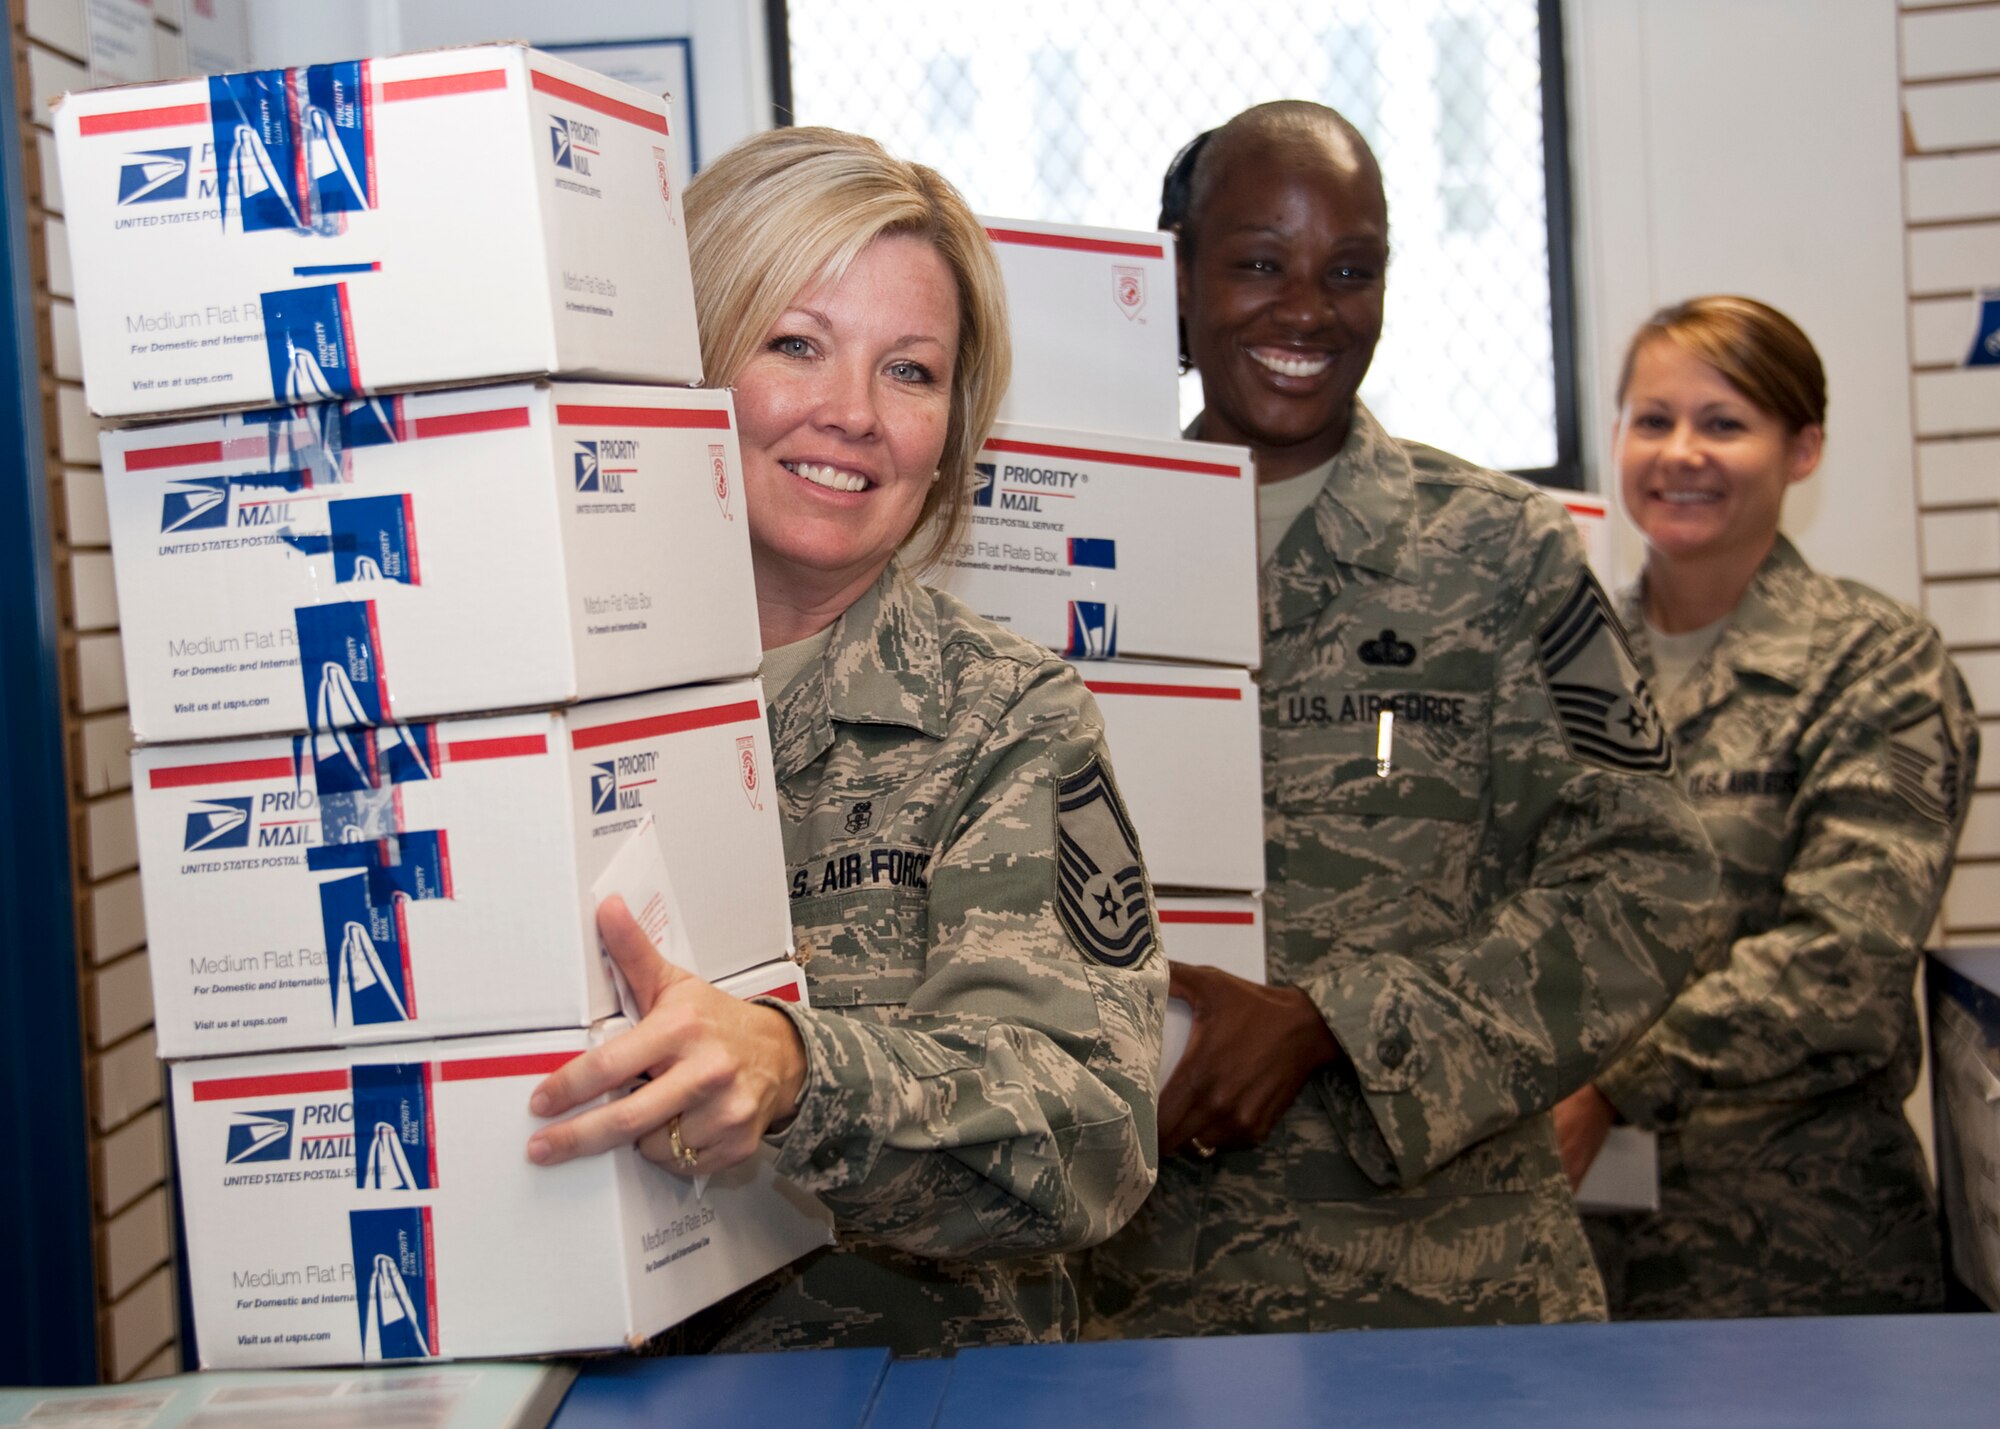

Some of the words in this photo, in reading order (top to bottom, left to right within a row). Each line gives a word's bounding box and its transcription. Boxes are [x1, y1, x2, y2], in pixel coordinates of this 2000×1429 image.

[333, 79, 345, 127] PRIORITY
[260, 98, 271, 145] PRIORITY
[344, 102, 355, 128] MAIL
[570, 119, 600, 147] PRIORITY
[115, 215, 158, 230] UNITED
[160, 211, 200, 225] STATES
[126, 311, 201, 334] Medium
[206, 303, 239, 326] Flat
[131, 344, 148, 354] For
[151, 337, 199, 353] Domestic
[201, 335, 220, 347] and
[314, 321, 331, 368] PRIORITY
[327, 342, 339, 368] MAIL
[132, 380, 155, 391] Visit
[157, 381, 169, 389] us
[172, 379, 182, 388] at
[185, 373, 233, 386] usps.com
[600, 440, 636, 460] PRIORITY
[602, 475, 624, 493] MAIL
[1003, 465, 1078, 489] PRIORITY
[1000, 493, 1043, 513] MAIL
[238, 502, 296, 528] MAIL
[971, 515, 1000, 527] STATES
[1000, 518, 1031, 530] POSTAL
[1032, 520, 1064, 532] SERVICE
[159, 542, 200, 556] UNITED
[201, 539, 239, 552] STATES
[379, 528, 392, 576] PRIORITY
[978, 541, 1001, 558] Flat
[1002, 544, 1032, 560] Rate
[1034, 547, 1058, 563] Box
[955, 560, 991, 570] Domestic
[992, 563, 1008, 572] and
[1009, 565, 1056, 576] International
[169, 636, 240, 658] Medium
[245, 631, 276, 650] Flat
[280, 627, 300, 647] Ra
[173, 668, 190, 678] For
[191, 663, 237, 676] Domestic
[239, 660, 258, 672] and
[174, 703, 195, 714] Visit
[197, 703, 209, 711] us
[212, 701, 221, 710] at
[223, 697, 270, 711] usps.com
[1288, 696, 1333, 723] U.S.
[1339, 694, 1384, 722] AIR
[1392, 692, 1466, 725] FORCE
[618, 752, 656, 777] PRIORITY
[261, 789, 314, 813] PRIO
[619, 789, 643, 811] MAIL
[258, 825, 315, 848] MAIL
[181, 861, 221, 875] UNITED
[222, 858, 260, 872] STATES
[261, 855, 301, 869] POSTAL
[820, 853, 862, 894] AIR
[190, 955, 259, 975] Medium
[264, 951, 294, 969] Flat
[299, 948, 327, 967] Rat
[193, 986, 210, 995] For
[212, 982, 257, 993] Domestic
[258, 979, 277, 990] and
[194, 1020, 215, 1030] Visit
[217, 1020, 228, 1029] us
[230, 1019, 240, 1027] at
[242, 1016, 288, 1029] usps.com
[303, 1102, 354, 1125] PRIO
[401, 1098, 410, 1144] PRIORITY
[300, 1138, 356, 1160] MAIL
[223, 1174, 264, 1187] UNITED
[265, 1171, 301, 1184] STATES
[303, 1168, 343, 1181] POSTAL
[642, 1228, 670, 1253] Medium
[684, 1214, 701, 1232] Rate
[700, 1207, 716, 1226] Box
[398, 1228, 409, 1276] PRIORITY
[233, 1269, 301, 1289] Medium
[306, 1265, 337, 1284] Flat
[237, 1299, 253, 1309] For
[254, 1296, 299, 1308] Domestic
[301, 1294, 319, 1305] and
[238, 1335, 258, 1345] Visit
[260, 1335, 272, 1344] us
[274, 1334, 283, 1343] at
[285, 1331, 331, 1345] usps.com
